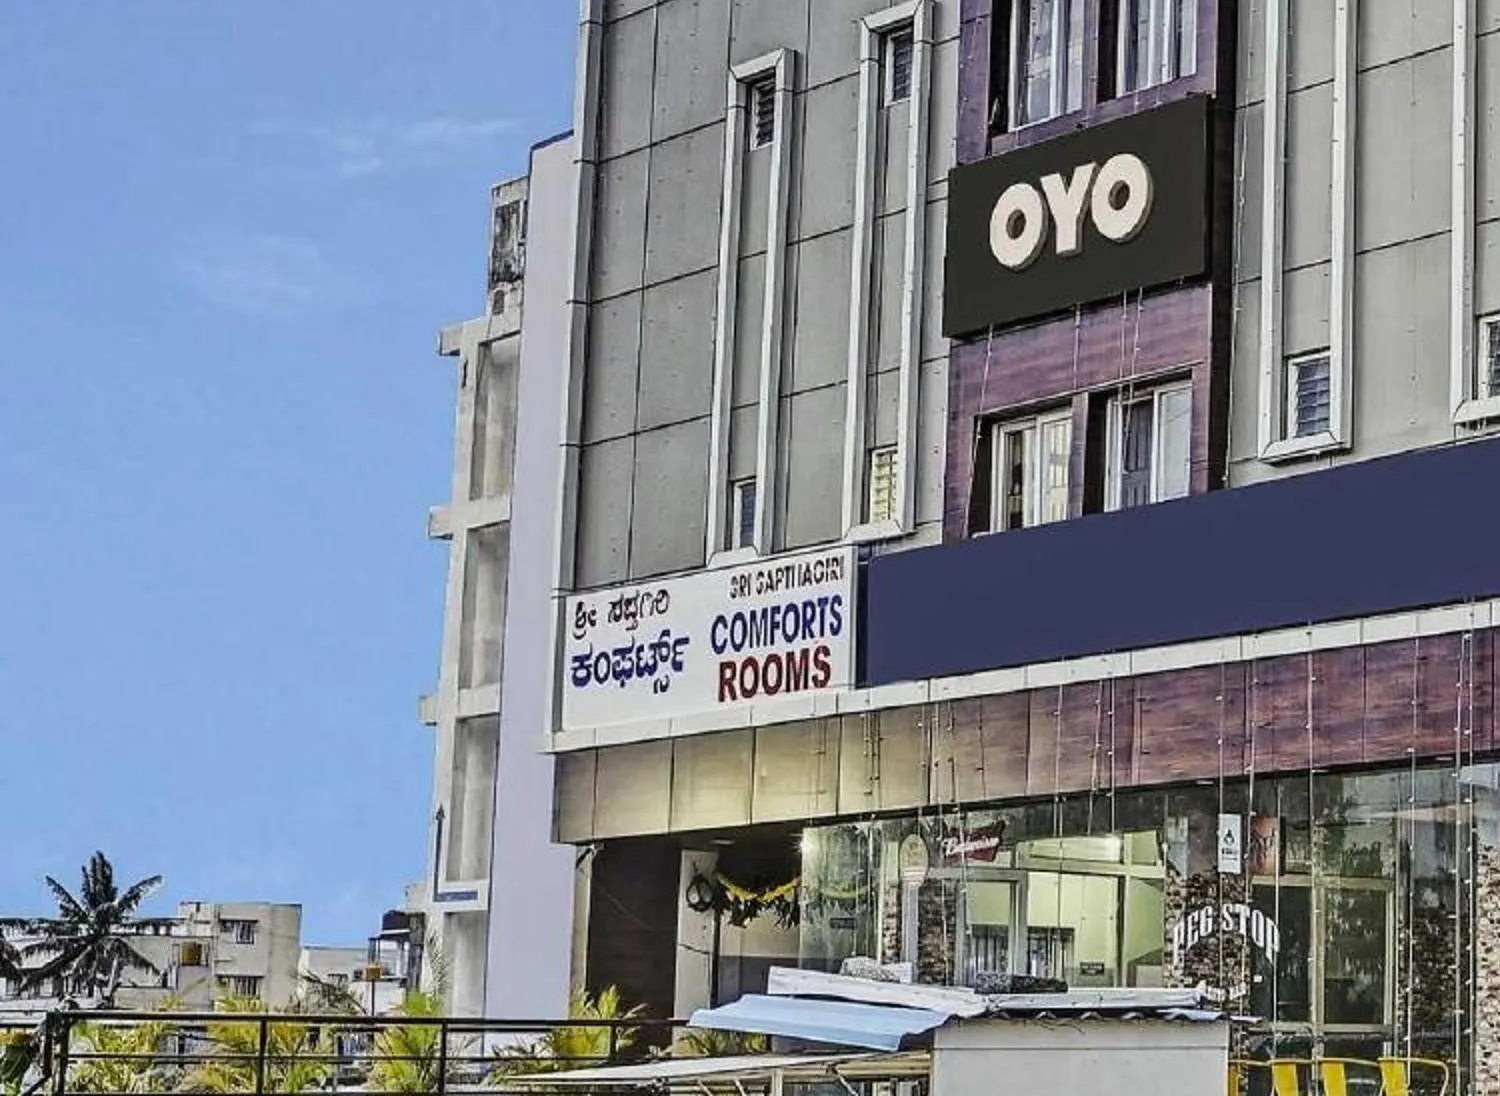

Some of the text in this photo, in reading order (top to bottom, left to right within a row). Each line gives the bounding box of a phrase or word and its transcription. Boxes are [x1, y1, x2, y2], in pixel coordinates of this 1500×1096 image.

[988, 153, 1154, 272] OYO
[730, 573, 752, 600] SRI
[711, 594, 843, 655] COMFORTS
[718, 644, 832, 703] ROOMS
[1222, 903, 1280, 964] STOP
